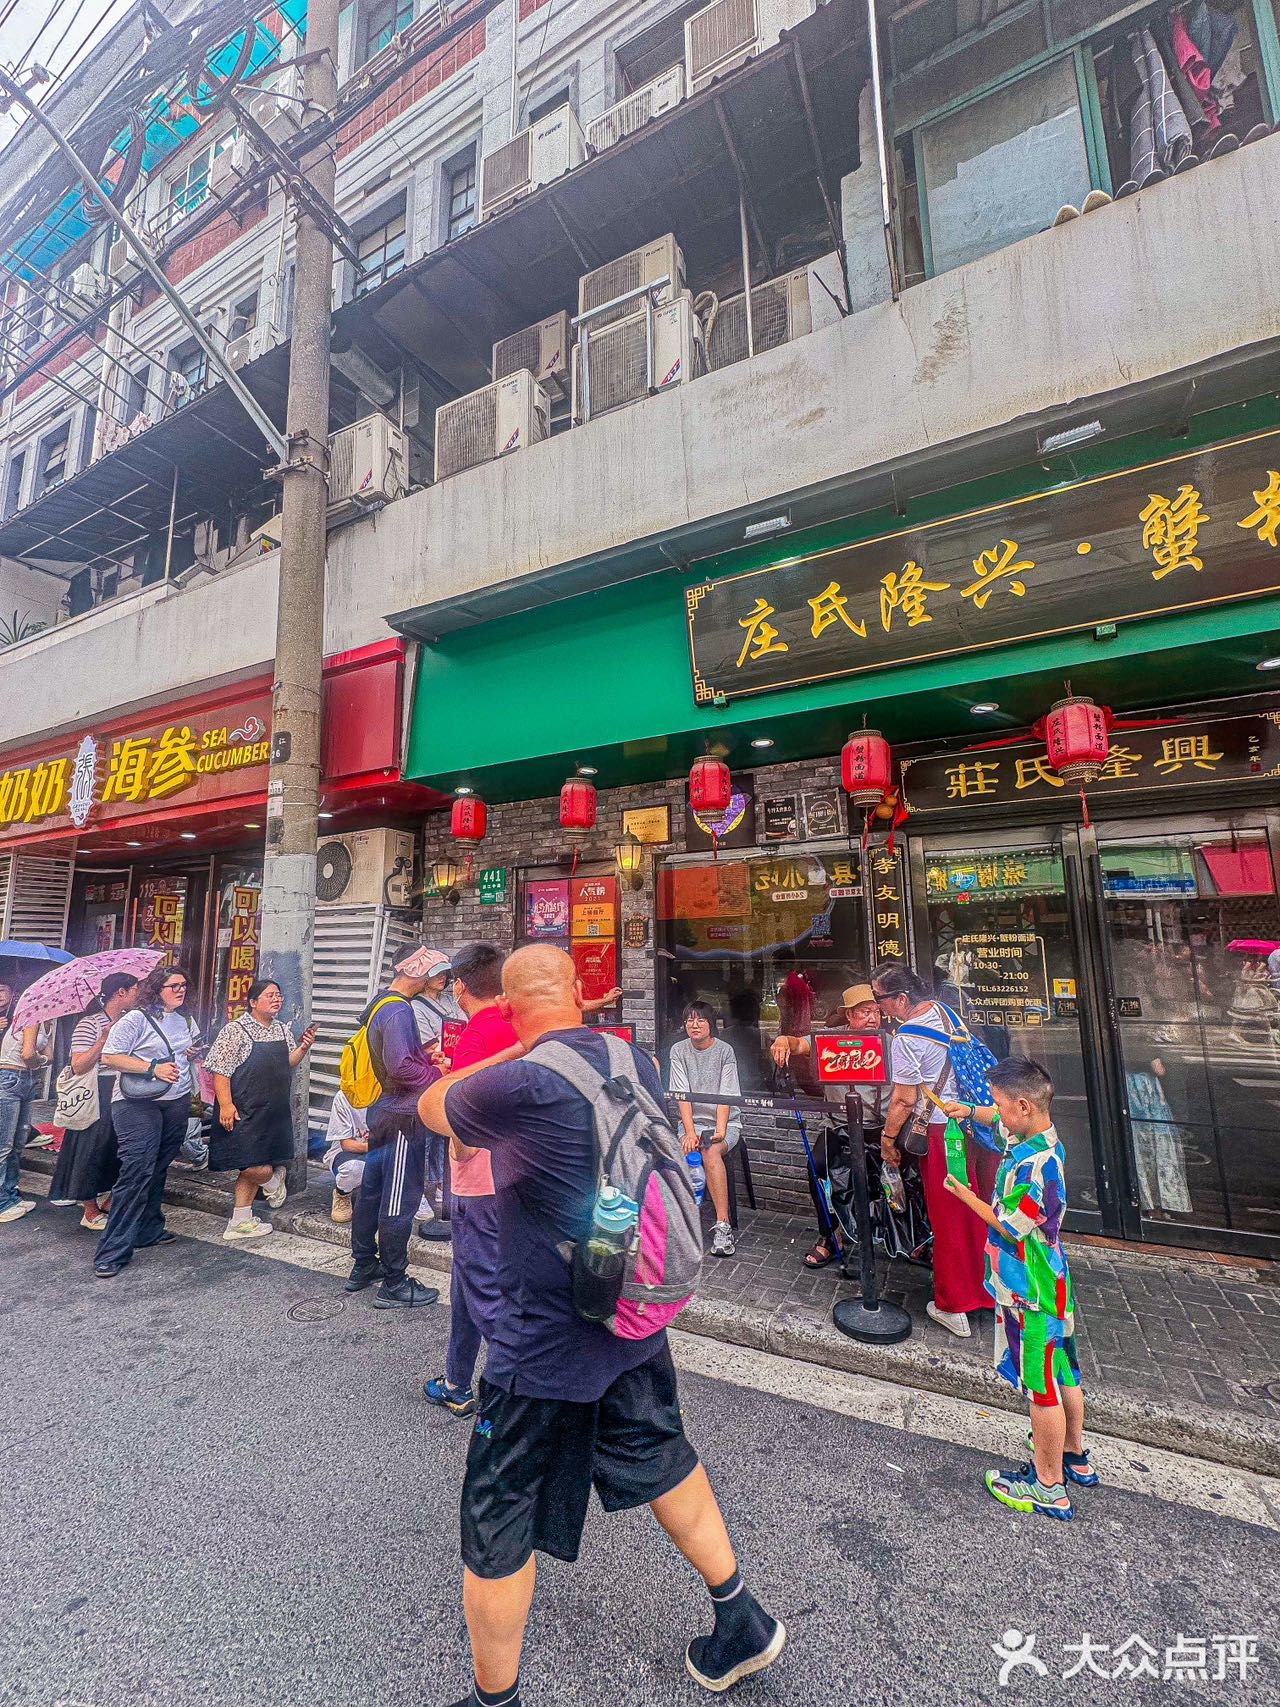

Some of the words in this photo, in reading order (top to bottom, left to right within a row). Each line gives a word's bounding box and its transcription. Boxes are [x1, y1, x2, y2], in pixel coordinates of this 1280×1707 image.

[202, 727, 228, 749] SEA
[102, 726, 197, 802] 海参
[483, 869, 501, 883] 441
[579, 886, 606, 897] 人气榜
[873, 857, 904, 957] 孝友明德
[962, 933, 1037, 943] 庄氏隆兴·蟹粉面道
[976, 947, 1023, 959] 营业时间
[977, 985, 1029, 993] TEL:63226152
[966, 997, 1042, 1008] 大众点评团购更优惠
